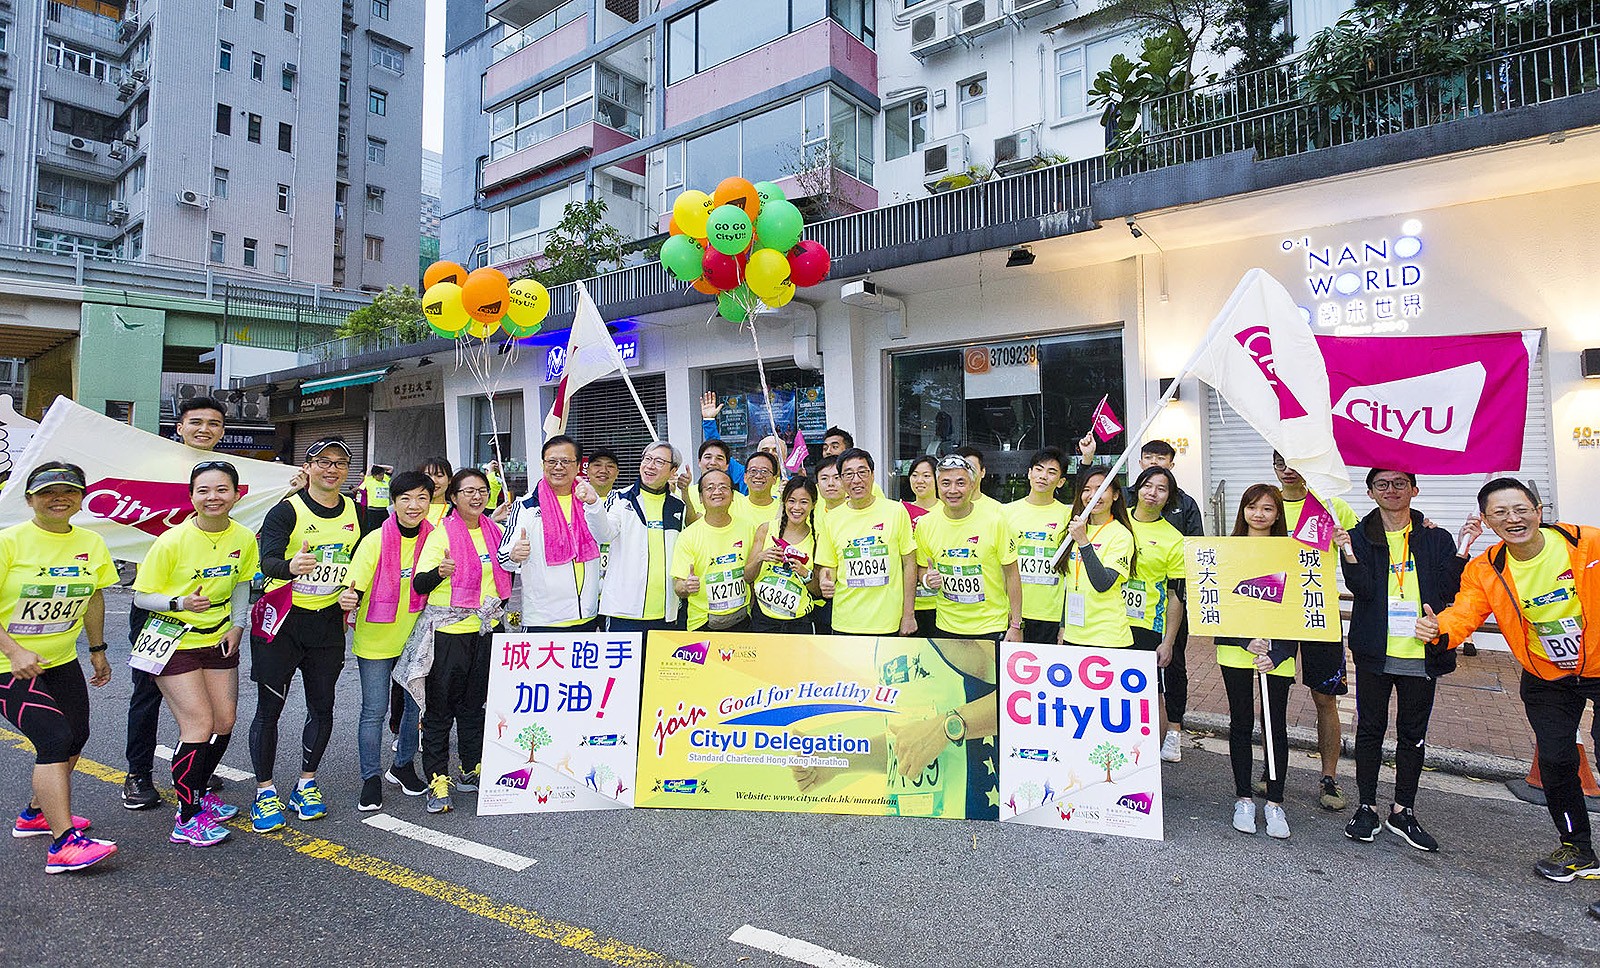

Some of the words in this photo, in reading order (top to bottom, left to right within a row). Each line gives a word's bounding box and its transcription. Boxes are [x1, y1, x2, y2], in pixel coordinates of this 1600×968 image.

[714, 223, 730, 231] GO
[732, 222, 746, 230] GO
[715, 232, 746, 241] CityU!!
[1309, 265, 1421, 296] WORLD
[524, 291, 538, 301] GO
[1345, 398, 1454, 441] CityU
[849, 558, 887, 576] K2694
[711, 579, 746, 601] K2700
[942, 576, 980, 593] K2698
[1196, 548, 1220, 624] 城大加油
[1239, 584, 1278, 600] CityU
[1299, 549, 1326, 629] 城大加油
[759, 584, 797, 610] K3843
[21, 599, 84, 621] K3847
[501, 640, 633, 671] 城大跑手
[675, 650, 703, 663] CityU
[719, 688, 763, 715] Goal
[763, 685, 793, 708] for
[797, 681, 870, 704] Healthy
[875, 686, 898, 704] U!
[1006, 690, 1151, 740] CityU!
[653, 702, 707, 756] join
[690, 730, 747, 751] CityU
[754, 732, 870, 755] Delegation
[689, 753, 725, 763] Standard
[726, 754, 765, 764] Chartered
[766, 756, 786, 767] Hong
[788, 756, 809, 768] Kong
[811, 757, 848, 767] Marathon
[500, 775, 526, 789] CityU
[735, 791, 771, 801] Website:
[773, 793, 898, 806] www.cityu.edu.hk/marathon
[1120, 797, 1148, 812] CityU
